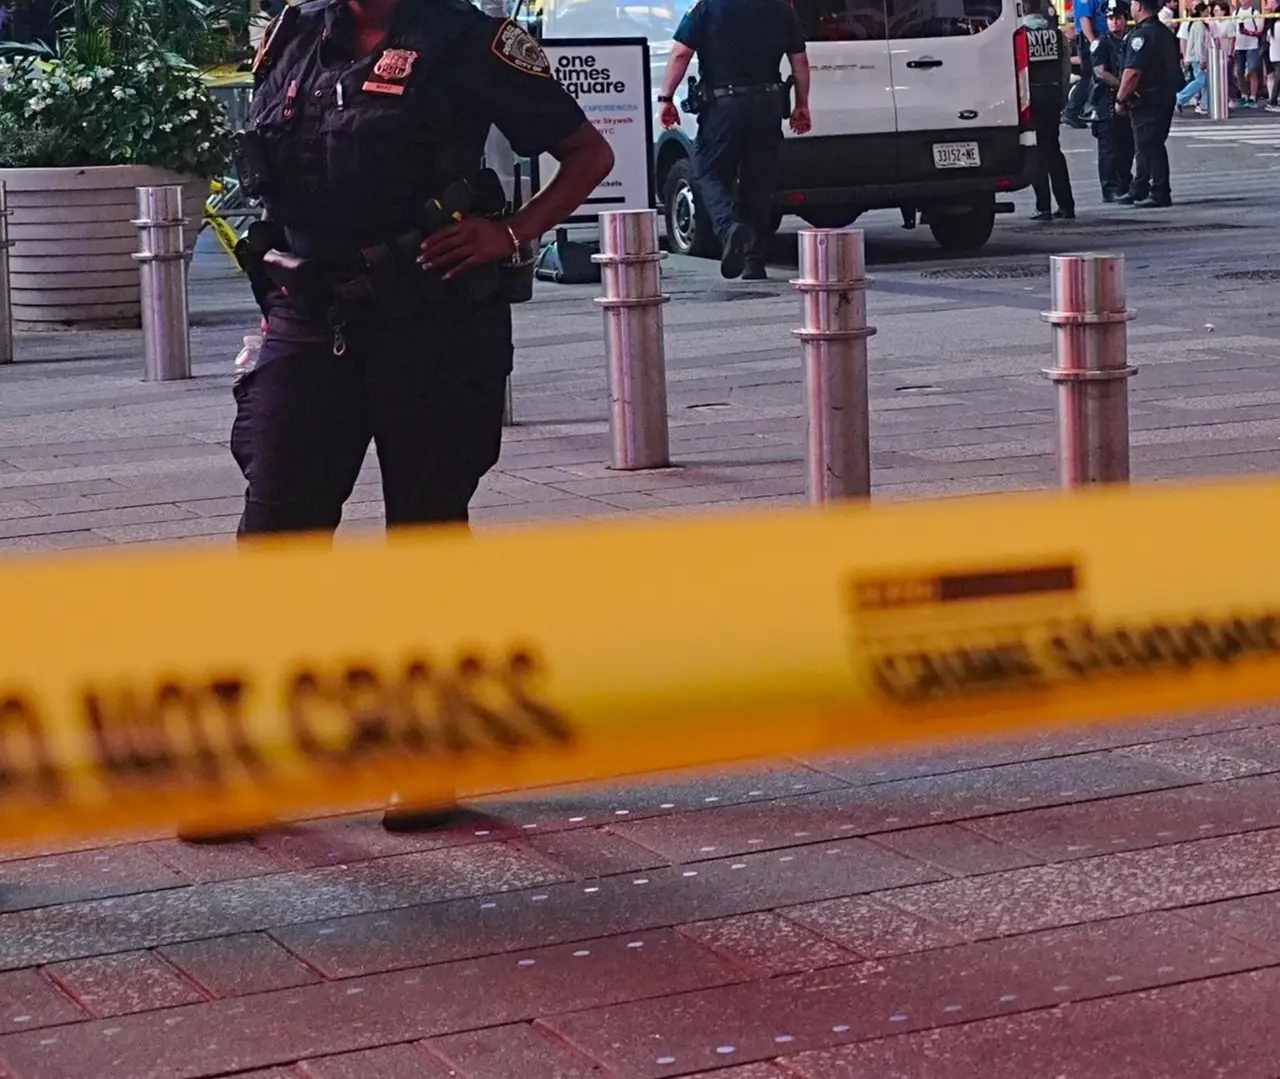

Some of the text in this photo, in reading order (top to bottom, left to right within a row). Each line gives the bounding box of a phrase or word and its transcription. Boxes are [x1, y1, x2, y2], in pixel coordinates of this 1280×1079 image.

[1026, 30, 1057, 46] NYPD
[1029, 44, 1058, 57] POLICE
[558, 55, 596, 69] one
[554, 67, 611, 82] times
[80, 672, 260, 788] NOT
[283, 638, 582, 762] CROSS
